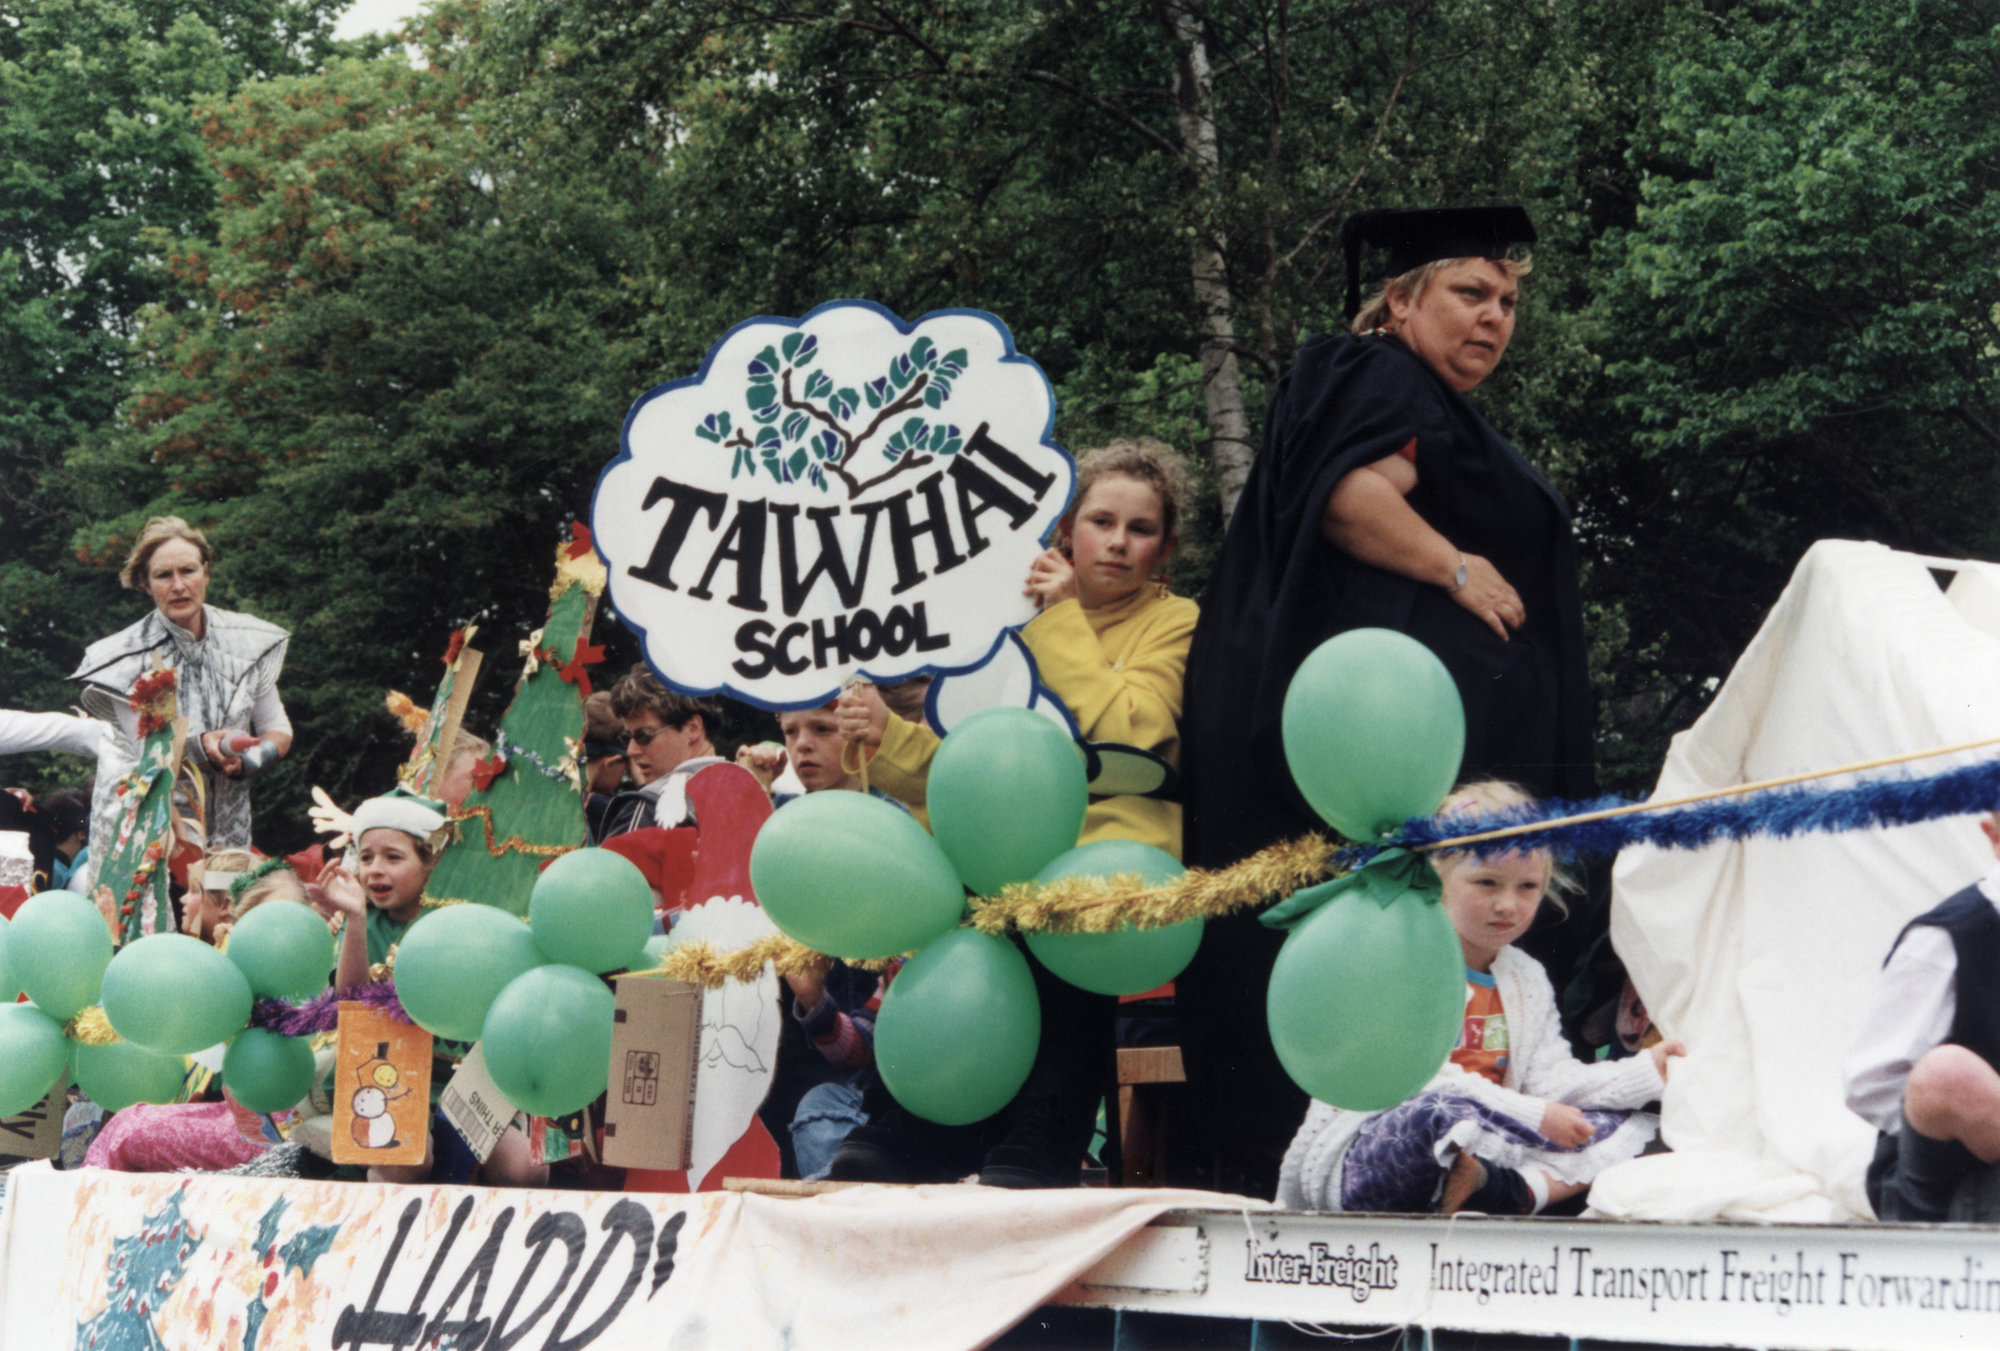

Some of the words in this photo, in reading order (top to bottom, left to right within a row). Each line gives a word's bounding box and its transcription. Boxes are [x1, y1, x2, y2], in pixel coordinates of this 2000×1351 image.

[627, 421, 1057, 617] TAWHAI
[732, 601, 950, 680] SCHOOL
[469, 1091, 495, 1127] THINS
[1245, 1239, 1399, 1302] Inter-Freight
[1429, 1243, 1559, 1305] Integrated
[1570, 1247, 1709, 1312] Transport
[1720, 1250, 1826, 1316] Freight
